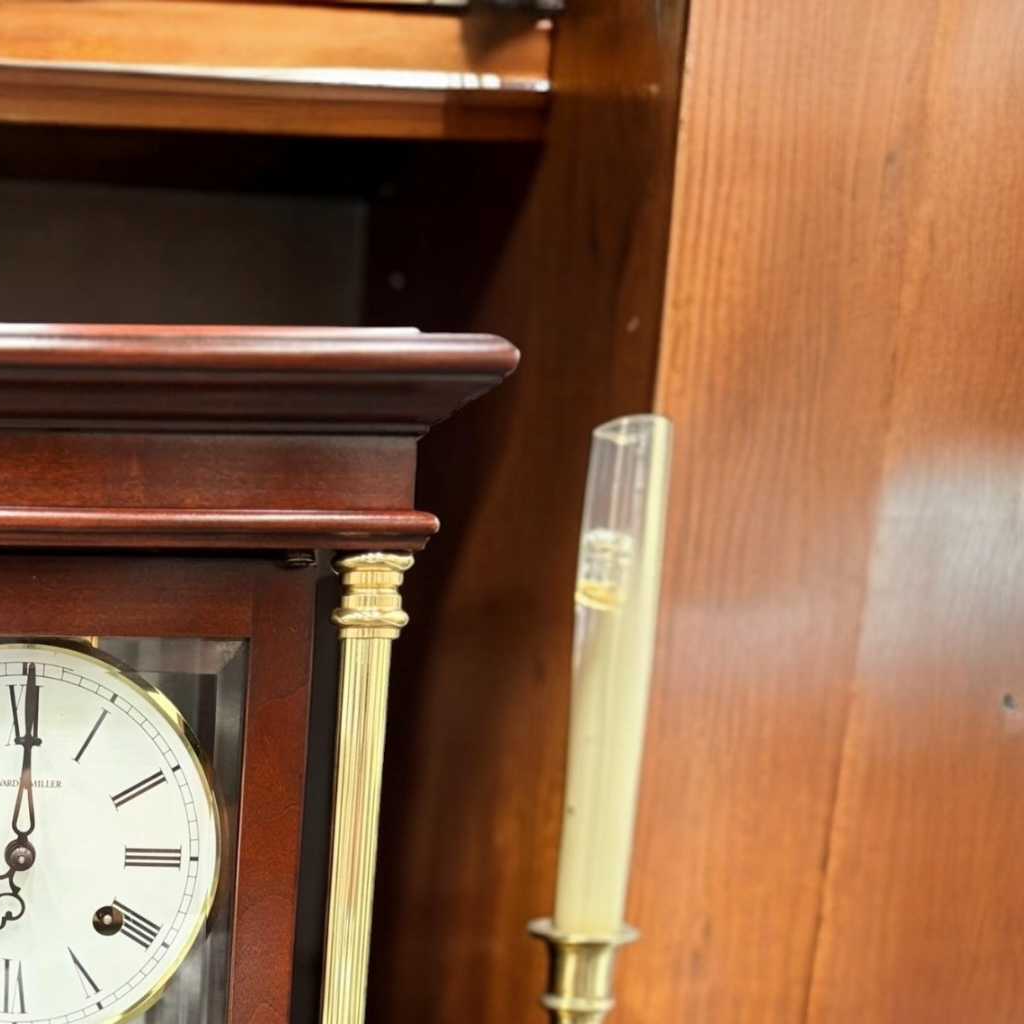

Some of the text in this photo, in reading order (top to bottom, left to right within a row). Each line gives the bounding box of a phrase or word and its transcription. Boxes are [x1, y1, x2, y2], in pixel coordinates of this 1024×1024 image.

[71, 707, 112, 764] I
[109, 767, 168, 811] II
[124, 845, 182, 871] III
[112, 896, 163, 952] IIII
[0, 958, 28, 1014] VI
[68, 946, 103, 998] V
